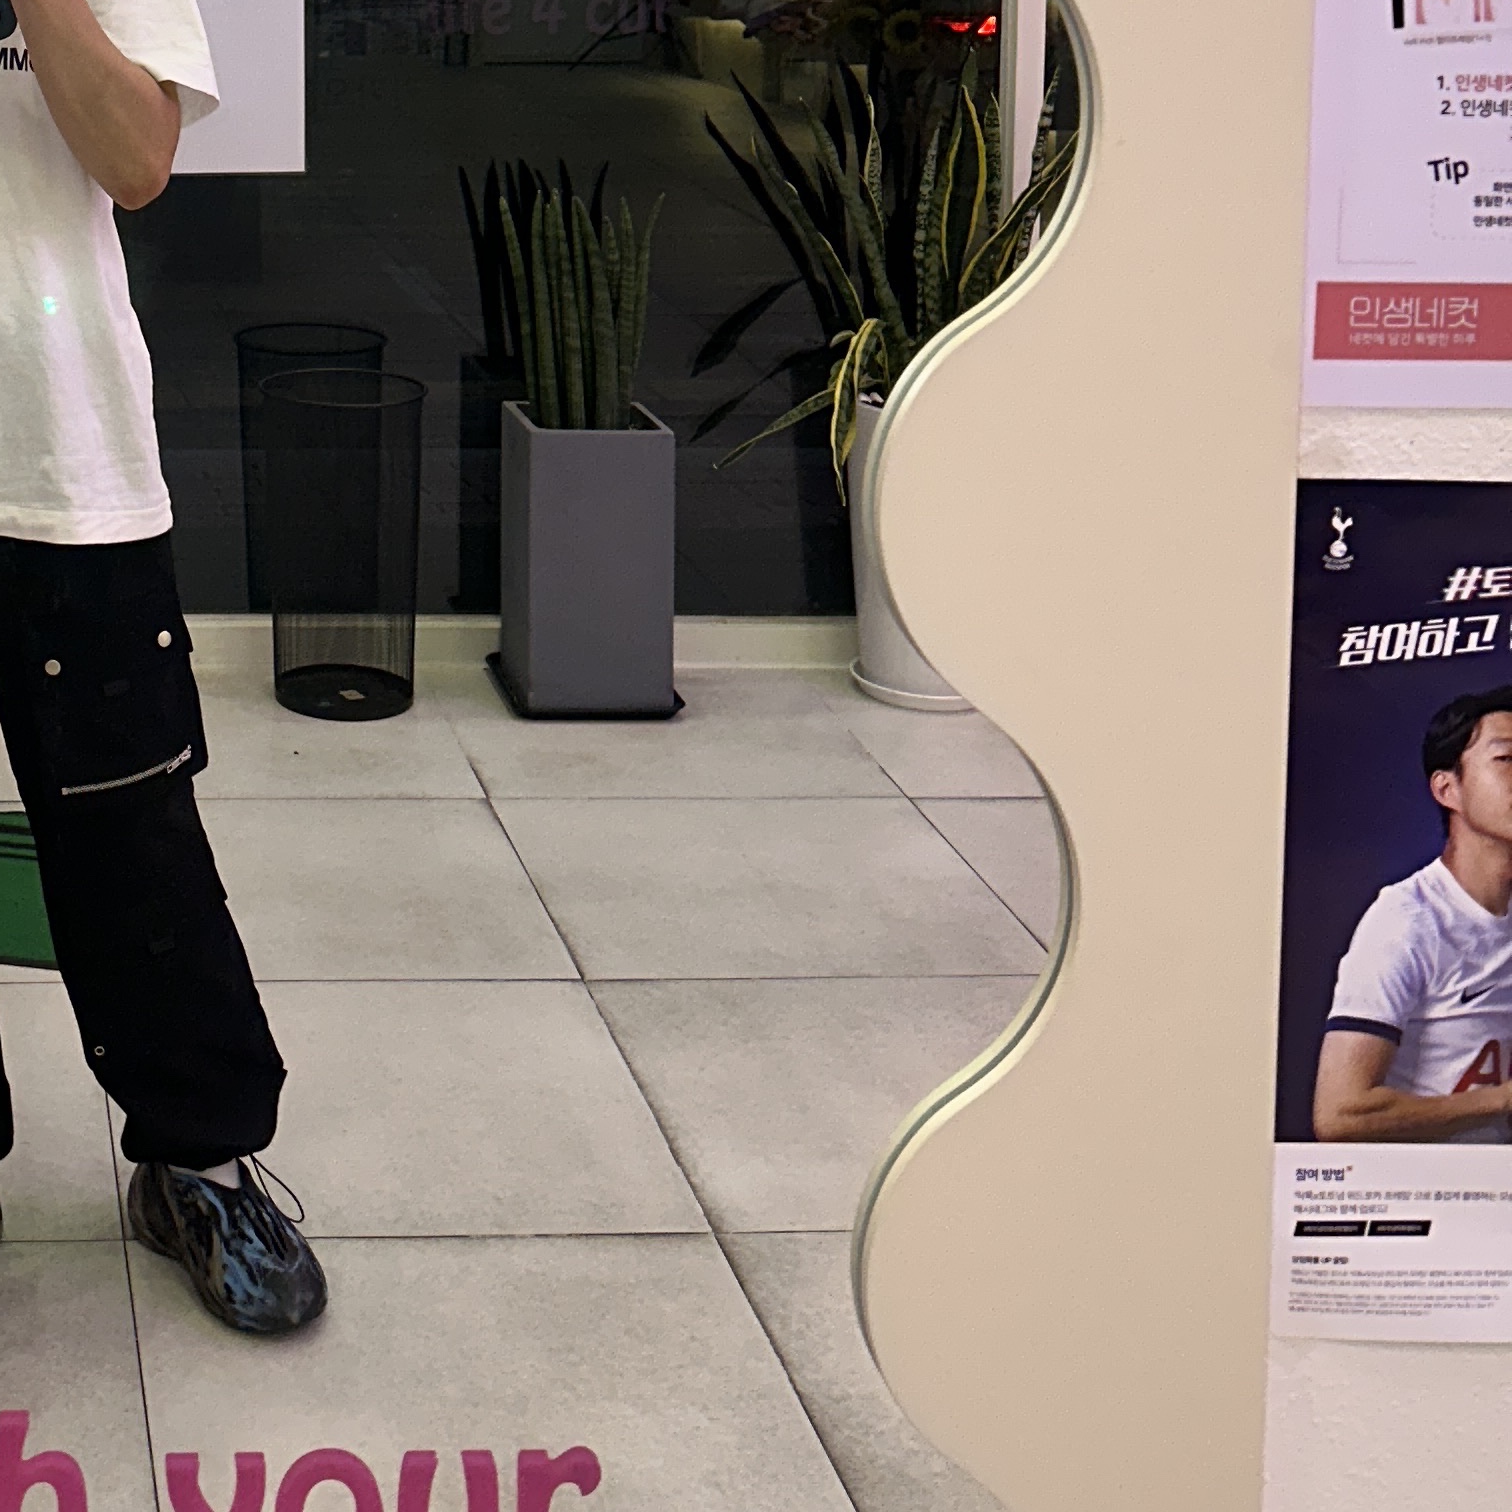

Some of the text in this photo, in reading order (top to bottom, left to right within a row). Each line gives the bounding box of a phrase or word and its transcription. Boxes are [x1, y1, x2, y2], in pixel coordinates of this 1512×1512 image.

[1460, 99, 1512, 118] 인생네
[1427, 157, 1470, 185] Tip
[1349, 296, 1480, 329] 인생네컷
[1338, 614, 1501, 668] 참여하고
[1451, 1038, 1512, 1094] A
